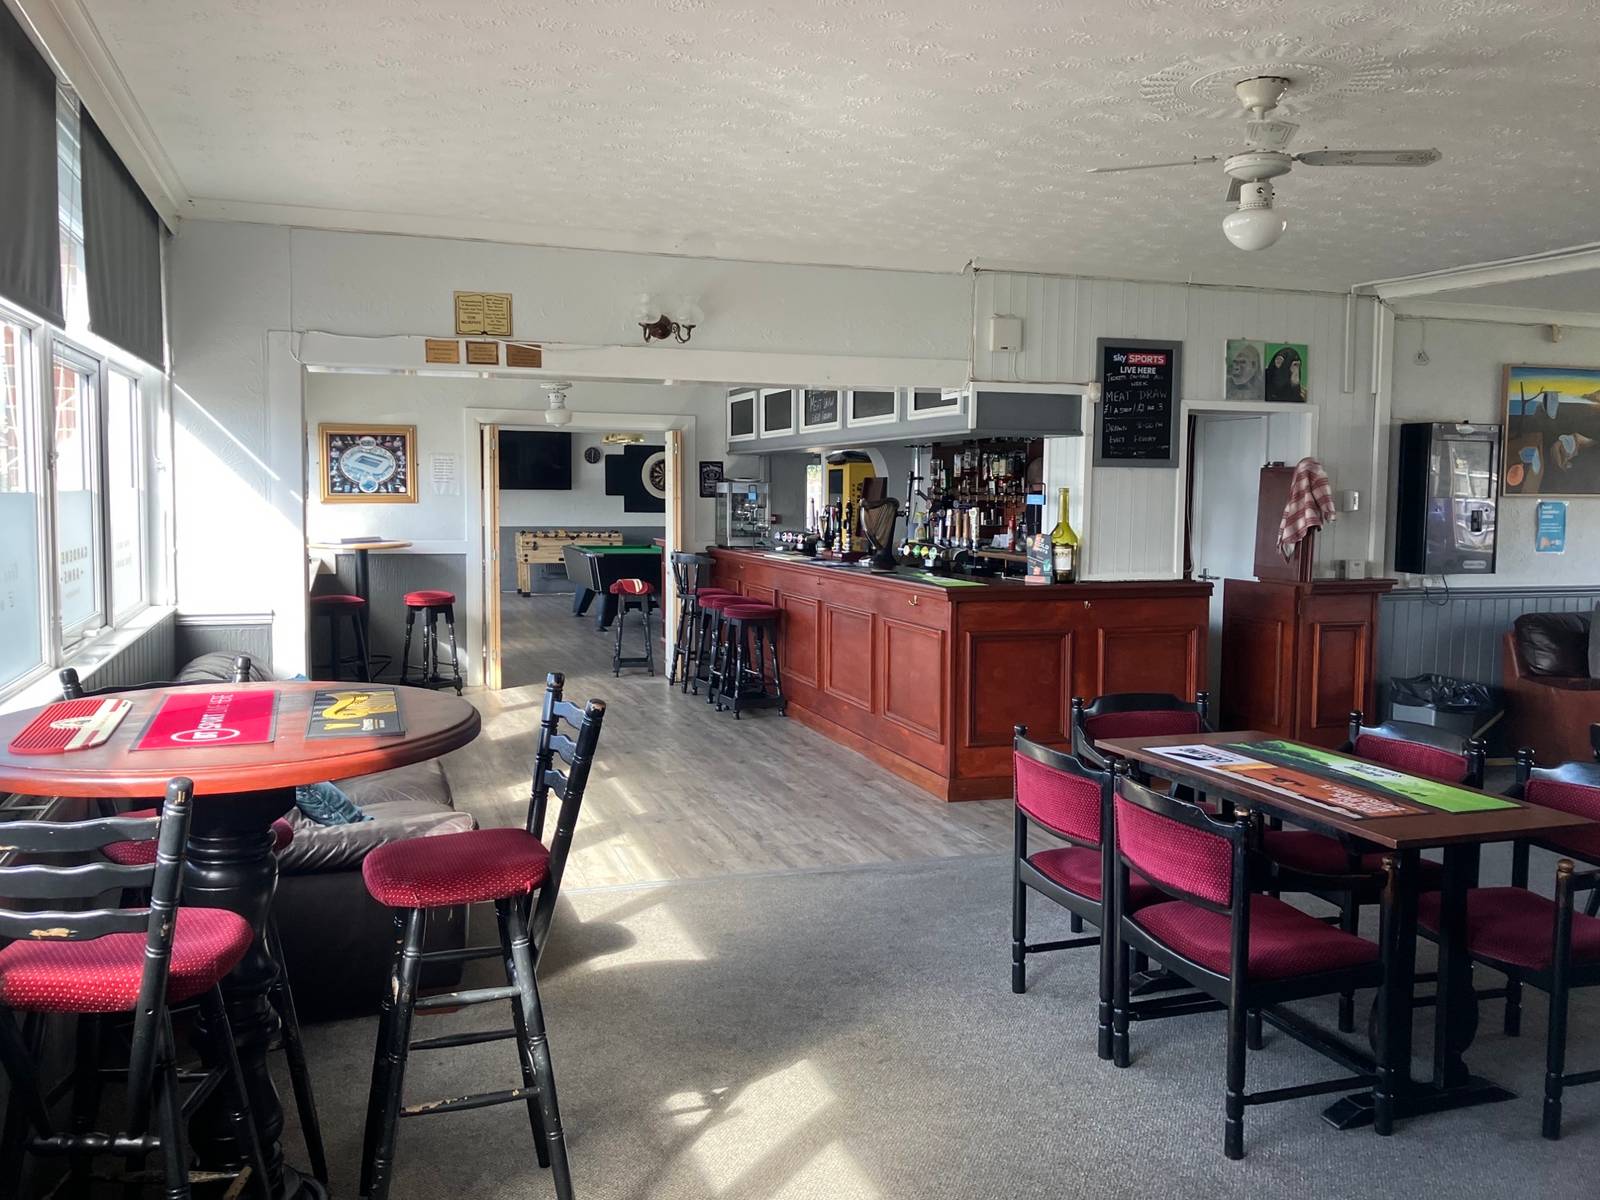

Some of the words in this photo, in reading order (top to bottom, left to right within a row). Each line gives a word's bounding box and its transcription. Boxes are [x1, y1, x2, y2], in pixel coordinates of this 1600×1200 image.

[1113, 353, 1126, 363] sky
[1129, 355, 1164, 364] SPORTS
[1120, 366, 1136, 374] LIVE
[1138, 367, 1156, 375] HERE
[1106, 391, 1130, 402] MEAT
[1139, 390, 1167, 400] DRAW
[198, 714, 224, 730] SPORT
